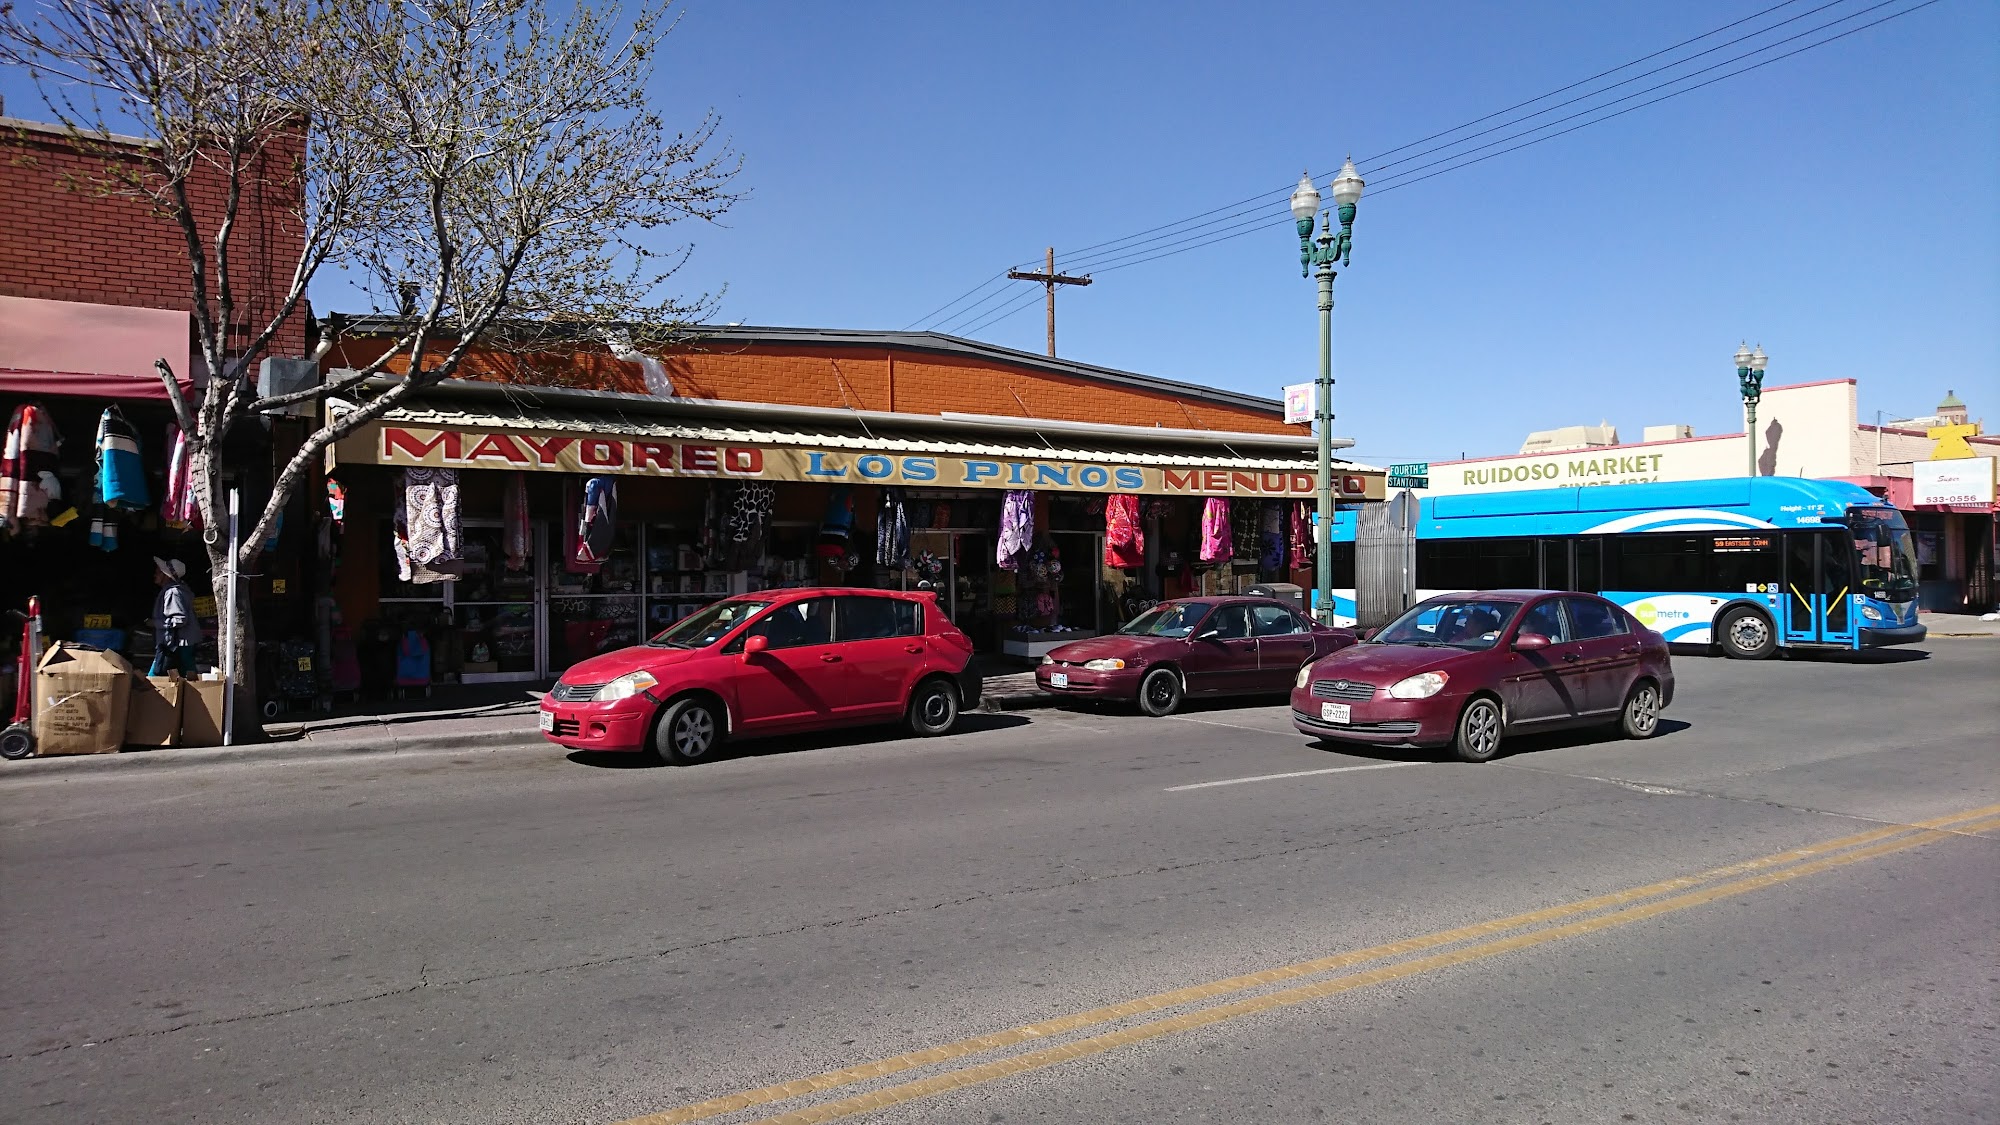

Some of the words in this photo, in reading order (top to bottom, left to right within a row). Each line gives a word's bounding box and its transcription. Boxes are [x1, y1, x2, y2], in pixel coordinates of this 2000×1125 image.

[381, 427, 764, 476] MAYOREO
[803, 450, 938, 481] LOS
[961, 459, 1145, 490] PINOS
[1391, 464, 1418, 475] FOURTH
[1463, 462, 1560, 486] RUIDOSO
[1568, 454, 1664, 478] MARKET
[1388, 477, 1419, 488] STANTON
[1926, 494, 1977, 503] 533-0556
